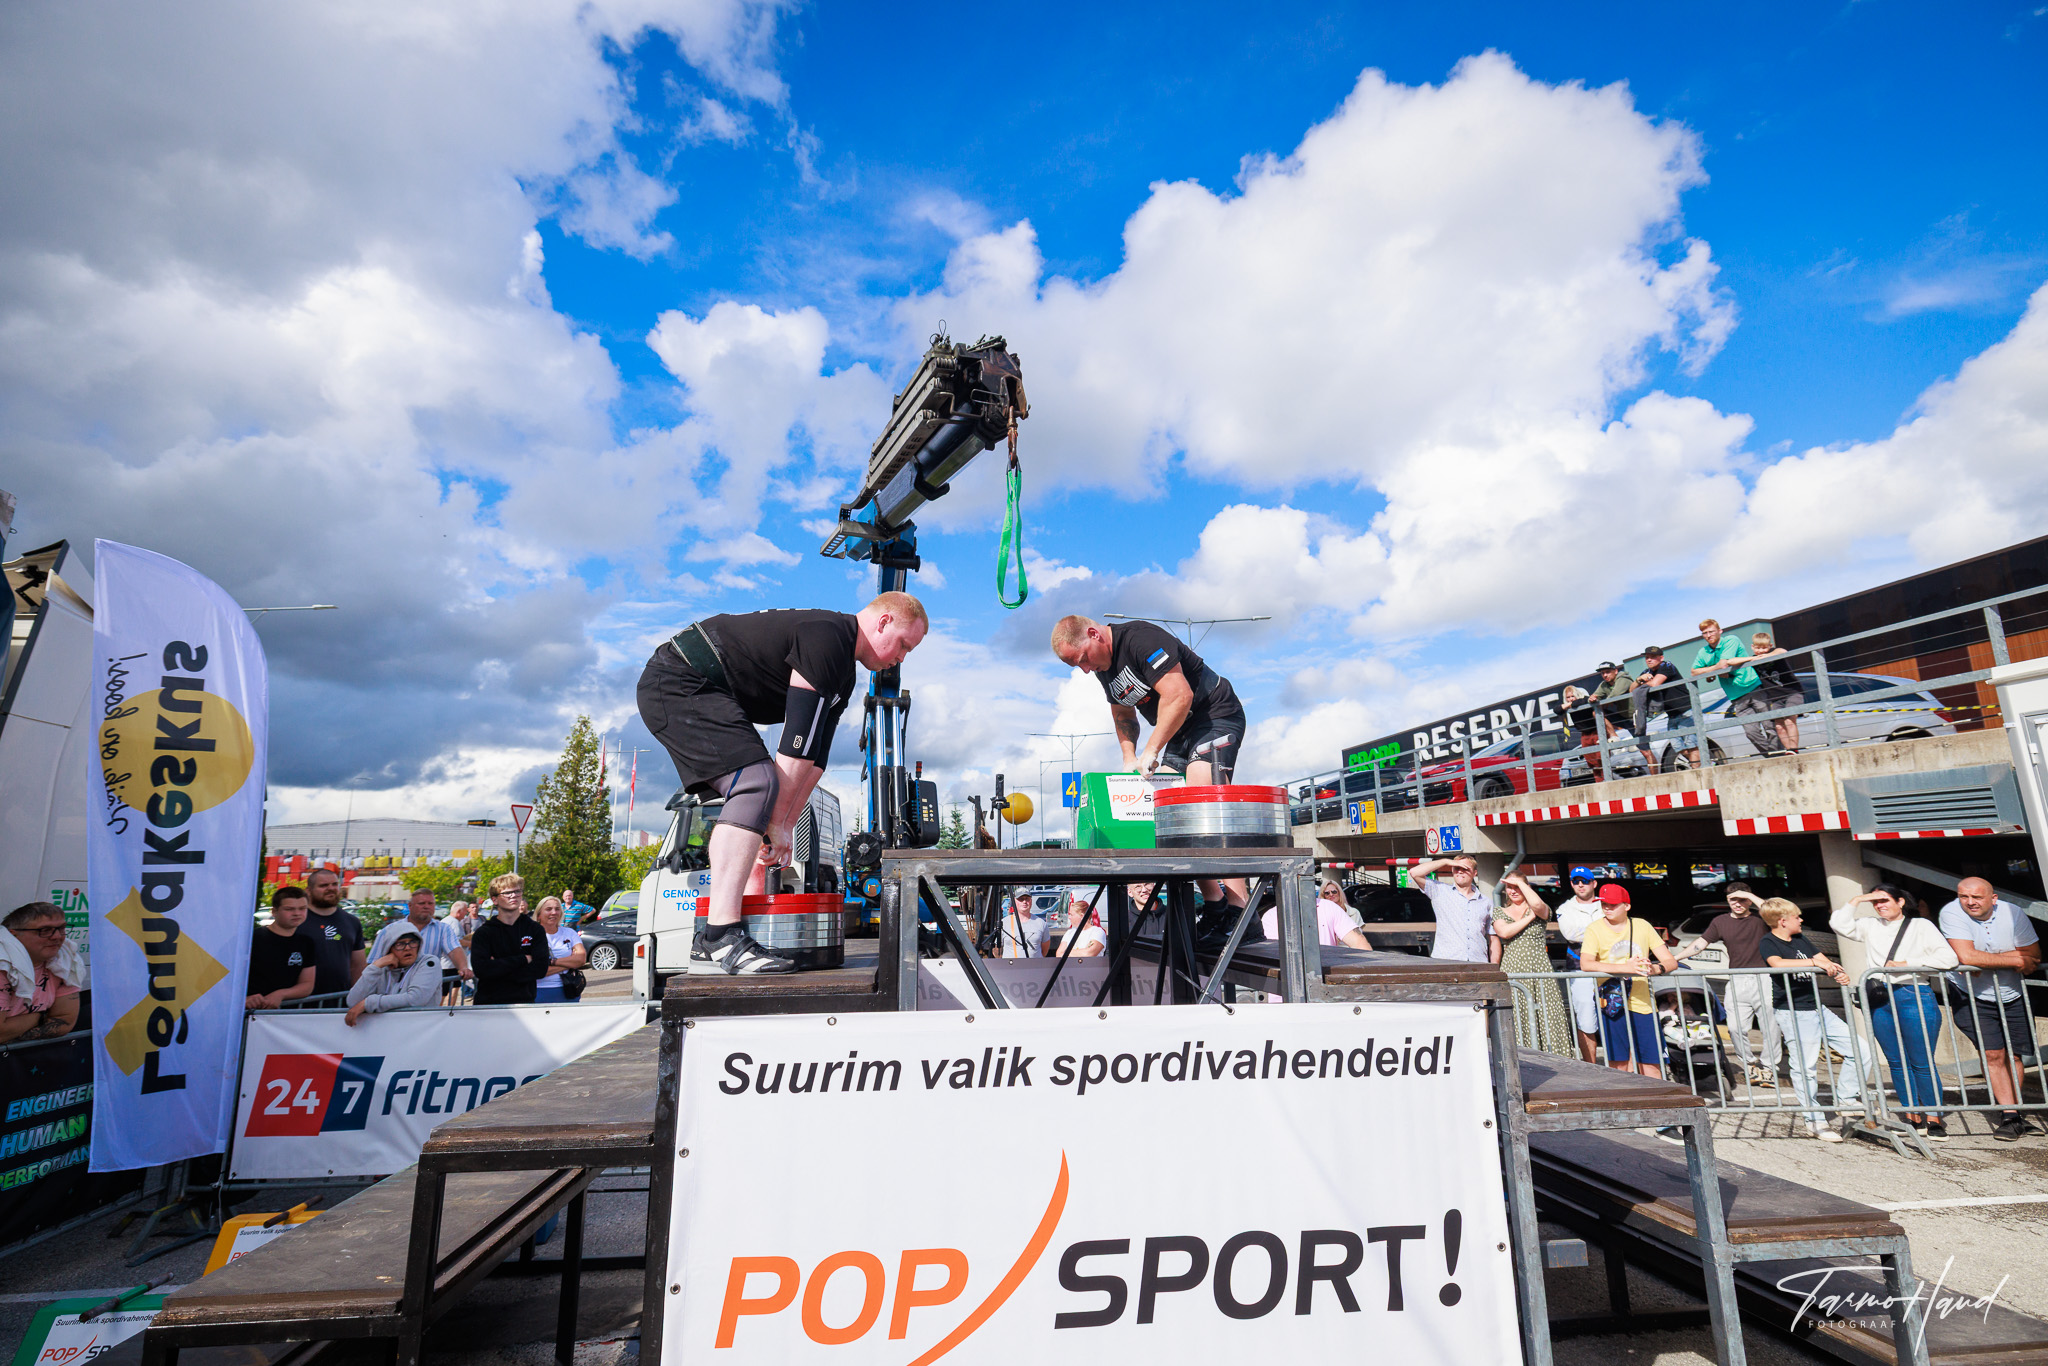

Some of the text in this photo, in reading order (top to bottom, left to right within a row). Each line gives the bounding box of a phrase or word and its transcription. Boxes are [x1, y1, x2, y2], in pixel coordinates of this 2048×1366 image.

[1413, 686, 1590, 762] RESERVE
[1065, 780, 1078, 798] 4
[1112, 794, 1136, 803] POP
[662, 889, 700, 898] GENNO
[718, 1036, 1454, 1096] Suurim valik spordivahendeid!
[6, 1083, 94, 1121] ENGINEER
[263, 1078, 321, 1116] 24
[341, 1081, 366, 1115] 7
[0, 1115, 87, 1158] HUMAN
[714, 1208, 1463, 1349] POP SPORT!
[40, 1347, 79, 1362] POP
